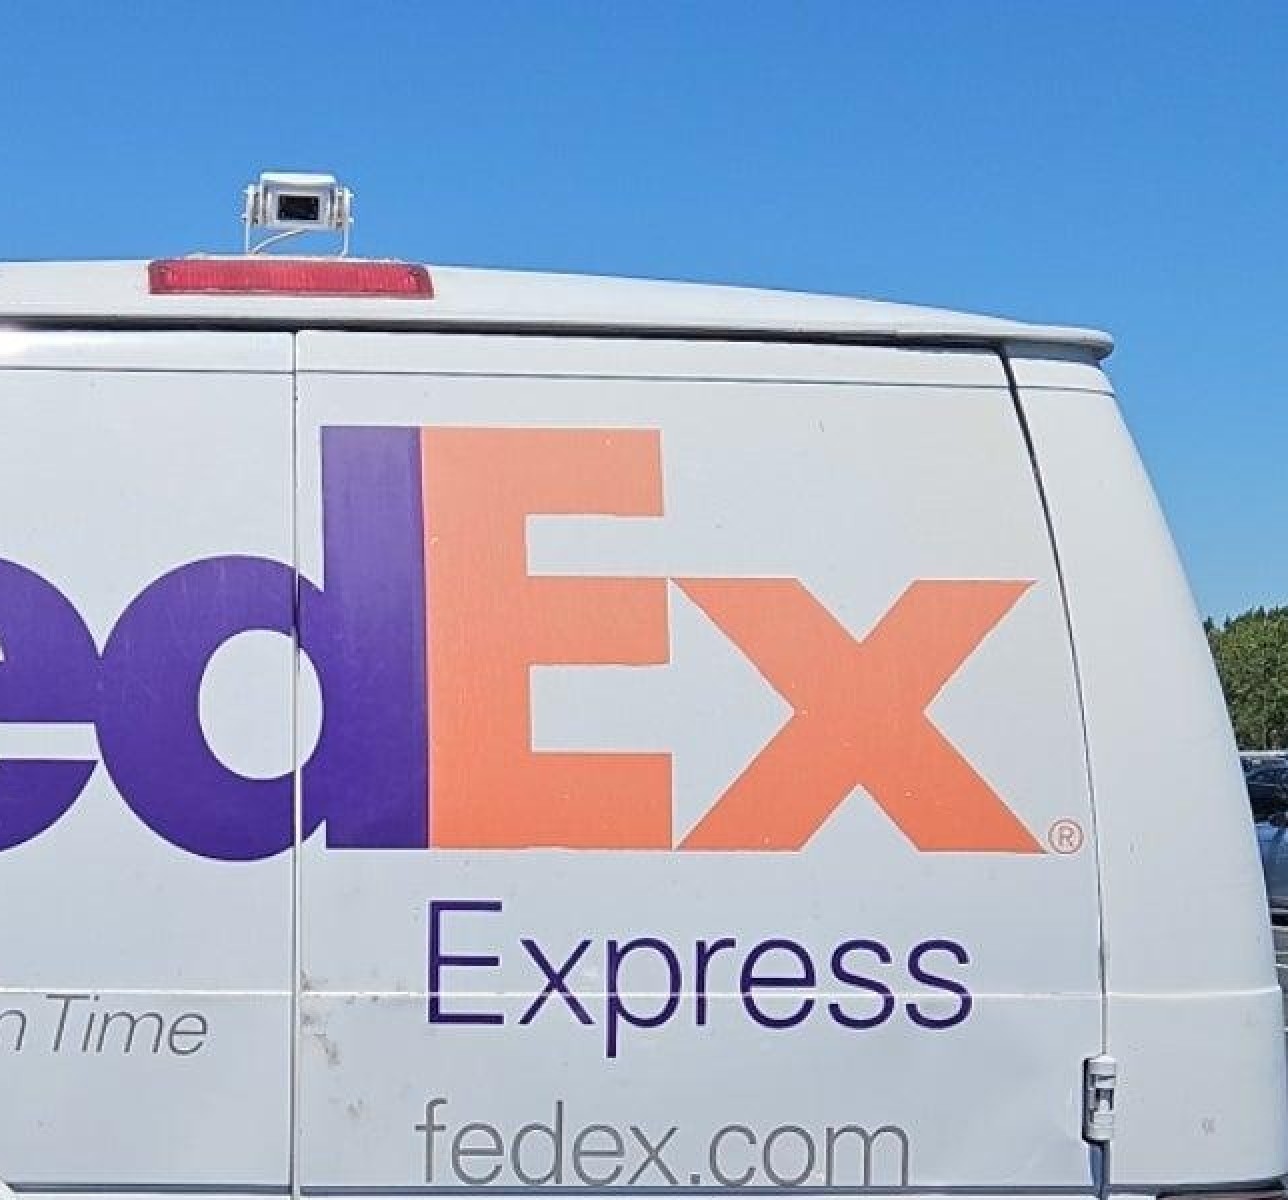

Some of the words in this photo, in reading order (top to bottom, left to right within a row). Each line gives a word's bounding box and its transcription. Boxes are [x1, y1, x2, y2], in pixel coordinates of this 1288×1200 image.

[427, 900, 973, 1059] Express
[45, 993, 209, 1056] Time
[415, 1098, 910, 1187] fedex.com
